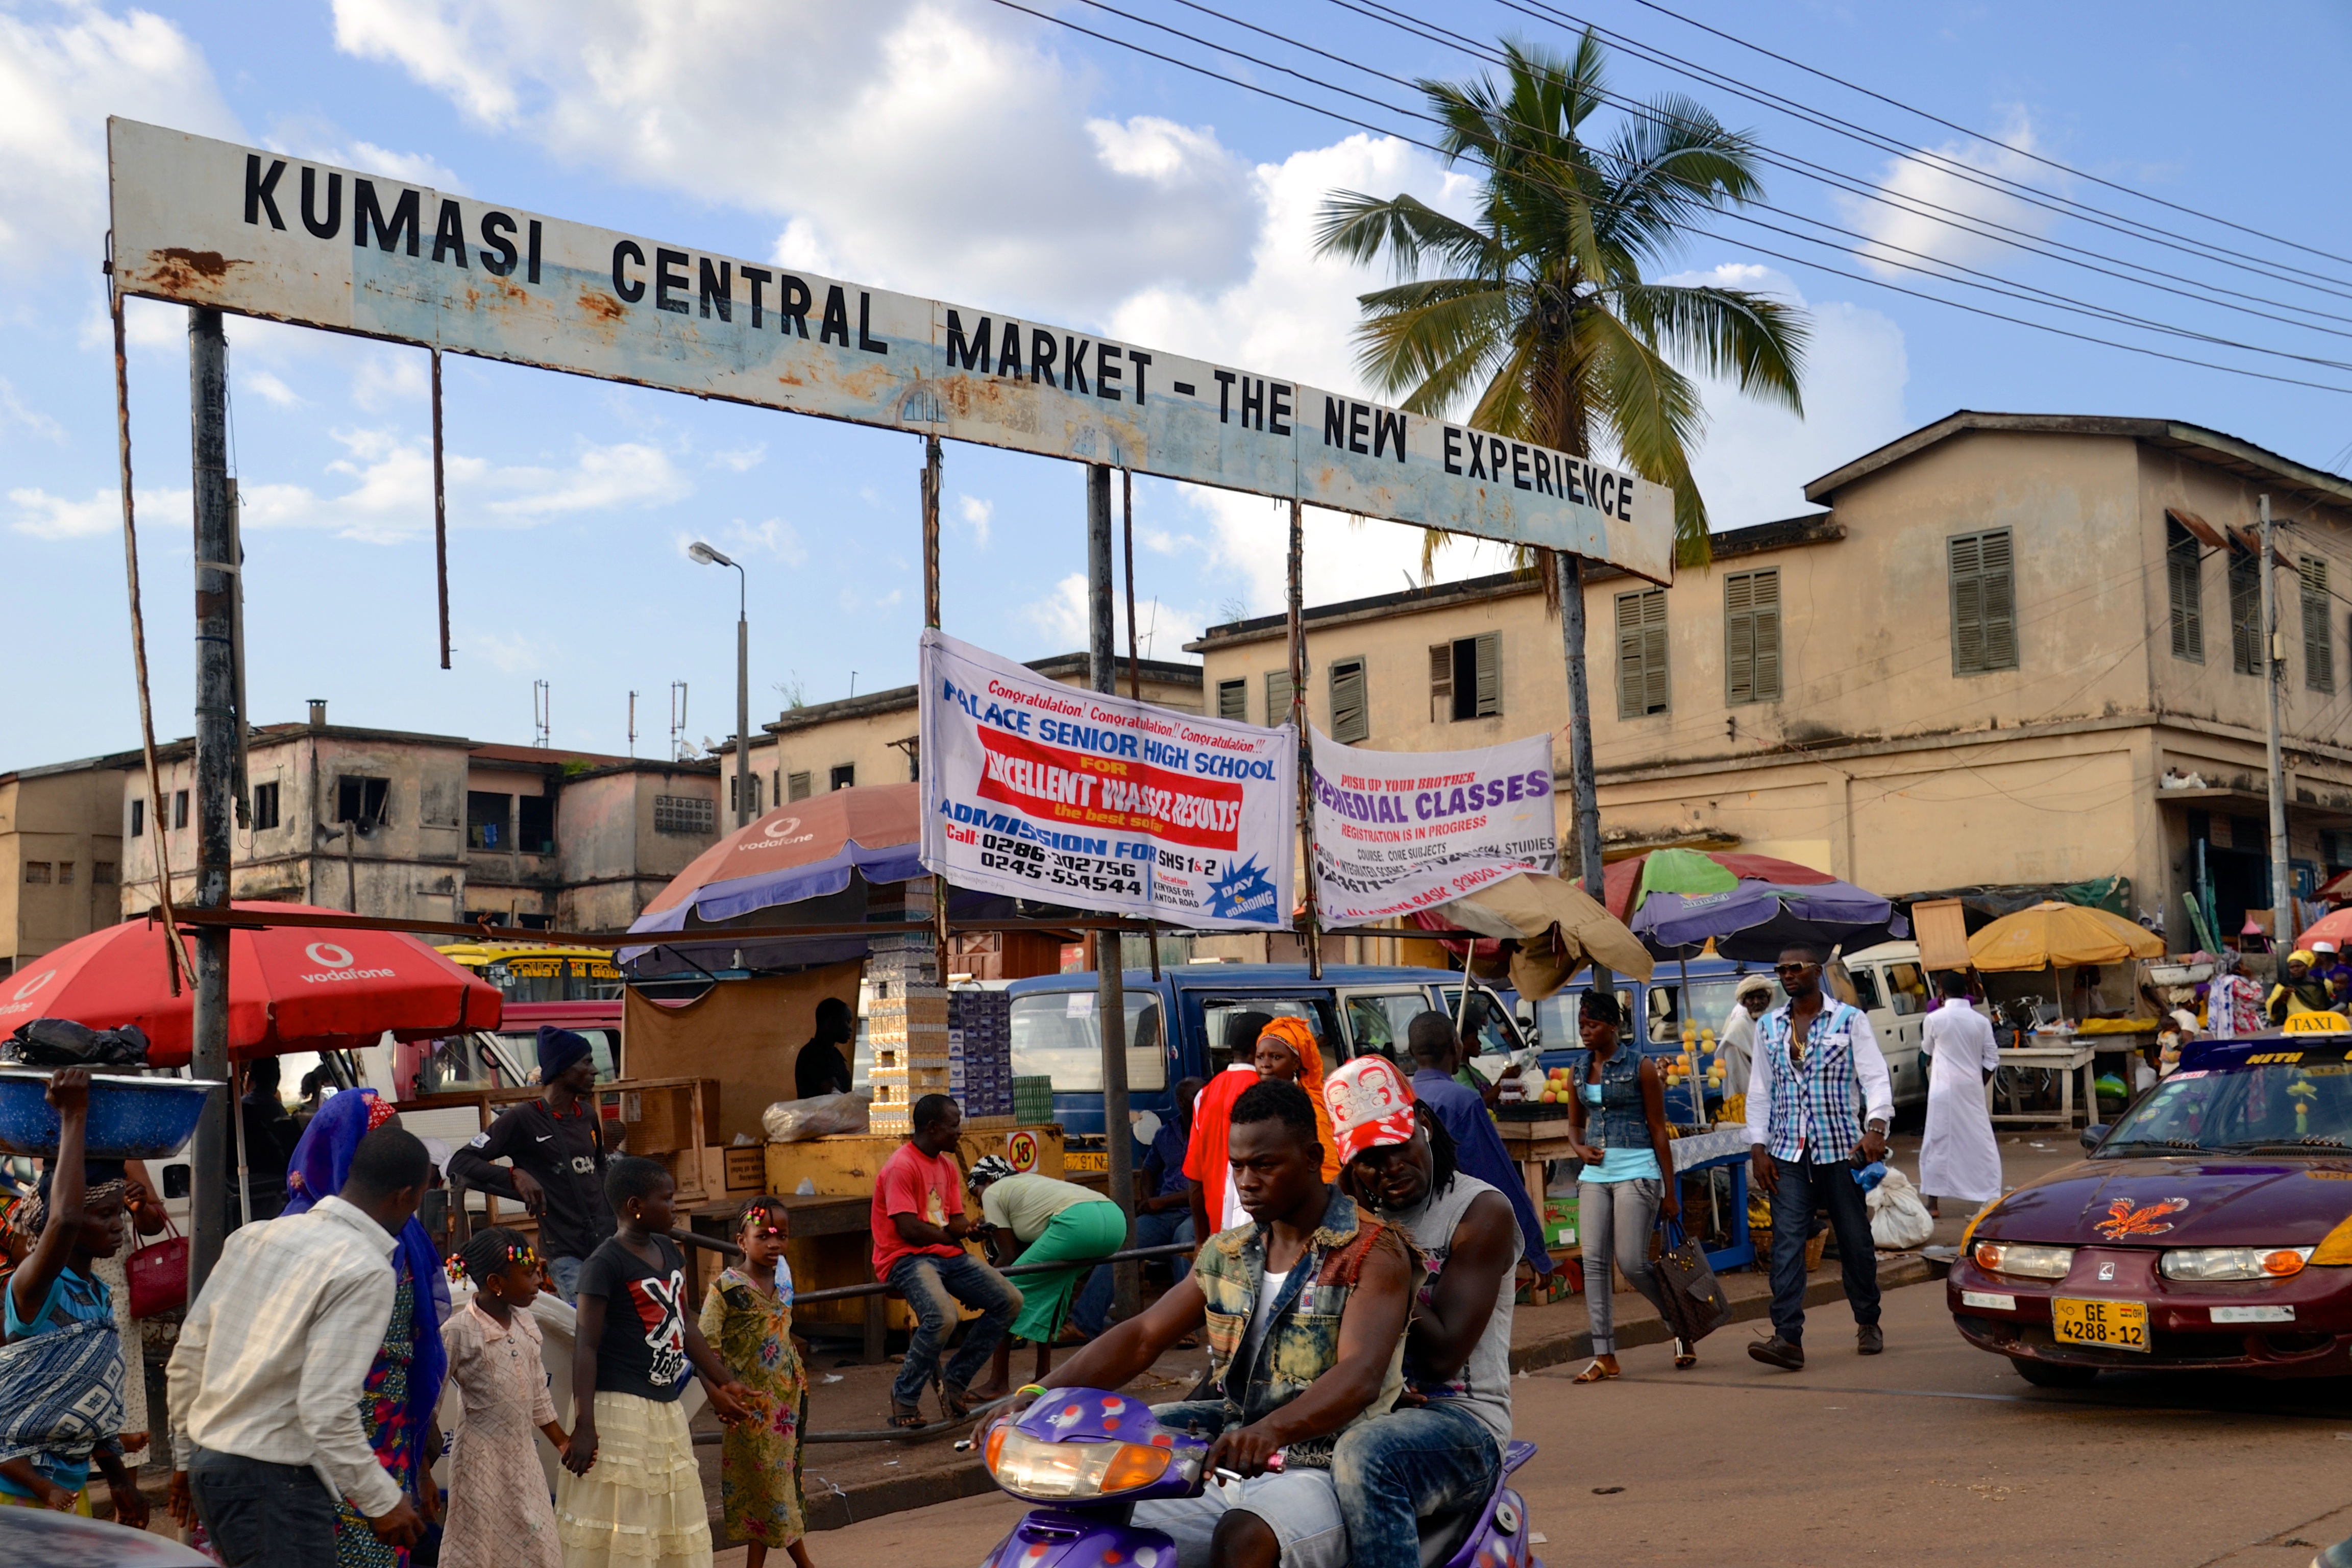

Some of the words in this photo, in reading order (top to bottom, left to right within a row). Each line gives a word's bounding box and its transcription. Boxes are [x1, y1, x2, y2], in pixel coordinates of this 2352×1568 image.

[244, 154, 542, 284] KUMASI
[612, 240, 888, 354] CENTRAL
[947, 310, 1152, 405] MARKET
[1214, 370, 1291, 436] THE
[1325, 396, 1407, 463] NEW
[1444, 427, 1633, 523] EXPERIENCE
[988, 680, 1087, 718] Congratulation!
[1090, 707, 1181, 738] Congratulation!!
[1181, 727, 1266, 754] Congratulation!!!
[944, 678, 1031, 736] PALACE
[1039, 719, 1138, 758] SENIOR
[1144, 739, 1189, 770] HIGH
[1194, 752, 1277, 780] SCHOOL
[1081, 756, 1128, 776] FOR
[985, 748, 1097, 807] EXCELLENT
[1102, 777, 1172, 822] WASSCE
[1172, 792, 1240, 832] RESULTS
[1340, 774, 1365, 791] PUSH
[1368, 778, 1382, 791] UP
[1385, 779, 1415, 792] YOUR
[1417, 772, 1476, 790] BROTHER
[1312, 767, 1409, 823] REMEDIAL
[1415, 770, 1550, 821] CLASSES
[1055, 803, 1082, 819] the
[1086, 808, 1125, 826] best
[939, 798, 1108, 855] ADMISSION
[1115, 843, 1157, 863] FOR
[1159, 850, 1184, 871] SHS
[1204, 860, 1216, 876] 2
[947, 824, 979, 845] Call:
[1341, 823, 1401, 843] REGISTRATION
[1403, 828, 1412, 842] IS
[1415, 827, 1426, 840] IN
[1429, 815, 1487, 838] PROGRESS
[738, 834, 814, 851] vodafone
[1357, 848, 1384, 862] COURSE:
[1388, 850, 1408, 862] CORE
[1409, 842, 1447, 859] SUBJECTS
[1339, 859, 1377, 878] INTEGRATED
[1505, 838, 1555, 855] STUDIES
[1154, 881, 1182, 896] KENYASE
[1182, 889, 1195, 898] OFF
[1160, 872, 1188, 886] Location
[1221, 875, 1255, 898] DAY
[1411, 886, 1452, 905] BASIC
[1453, 867, 1502, 892] SCHOOL
[1155, 892, 1178, 904] ANTOA
[1179, 897, 1199, 908] ROAD
[1225, 890, 1275, 918] BOARDING
[300, 968, 396, 983] vodafone
[507, 963, 561, 977] TRUST
[570, 962, 586, 977] IN
[591, 963, 620, 978] GOD
[2291, 1017, 2333, 1031] TAXI
[1016, 1142, 1030, 1163] 18
[641, 1269, 685, 1349] X
[2085, 1304, 2107, 1322] GE
[2064, 1320, 2142, 1345] 4288-12
